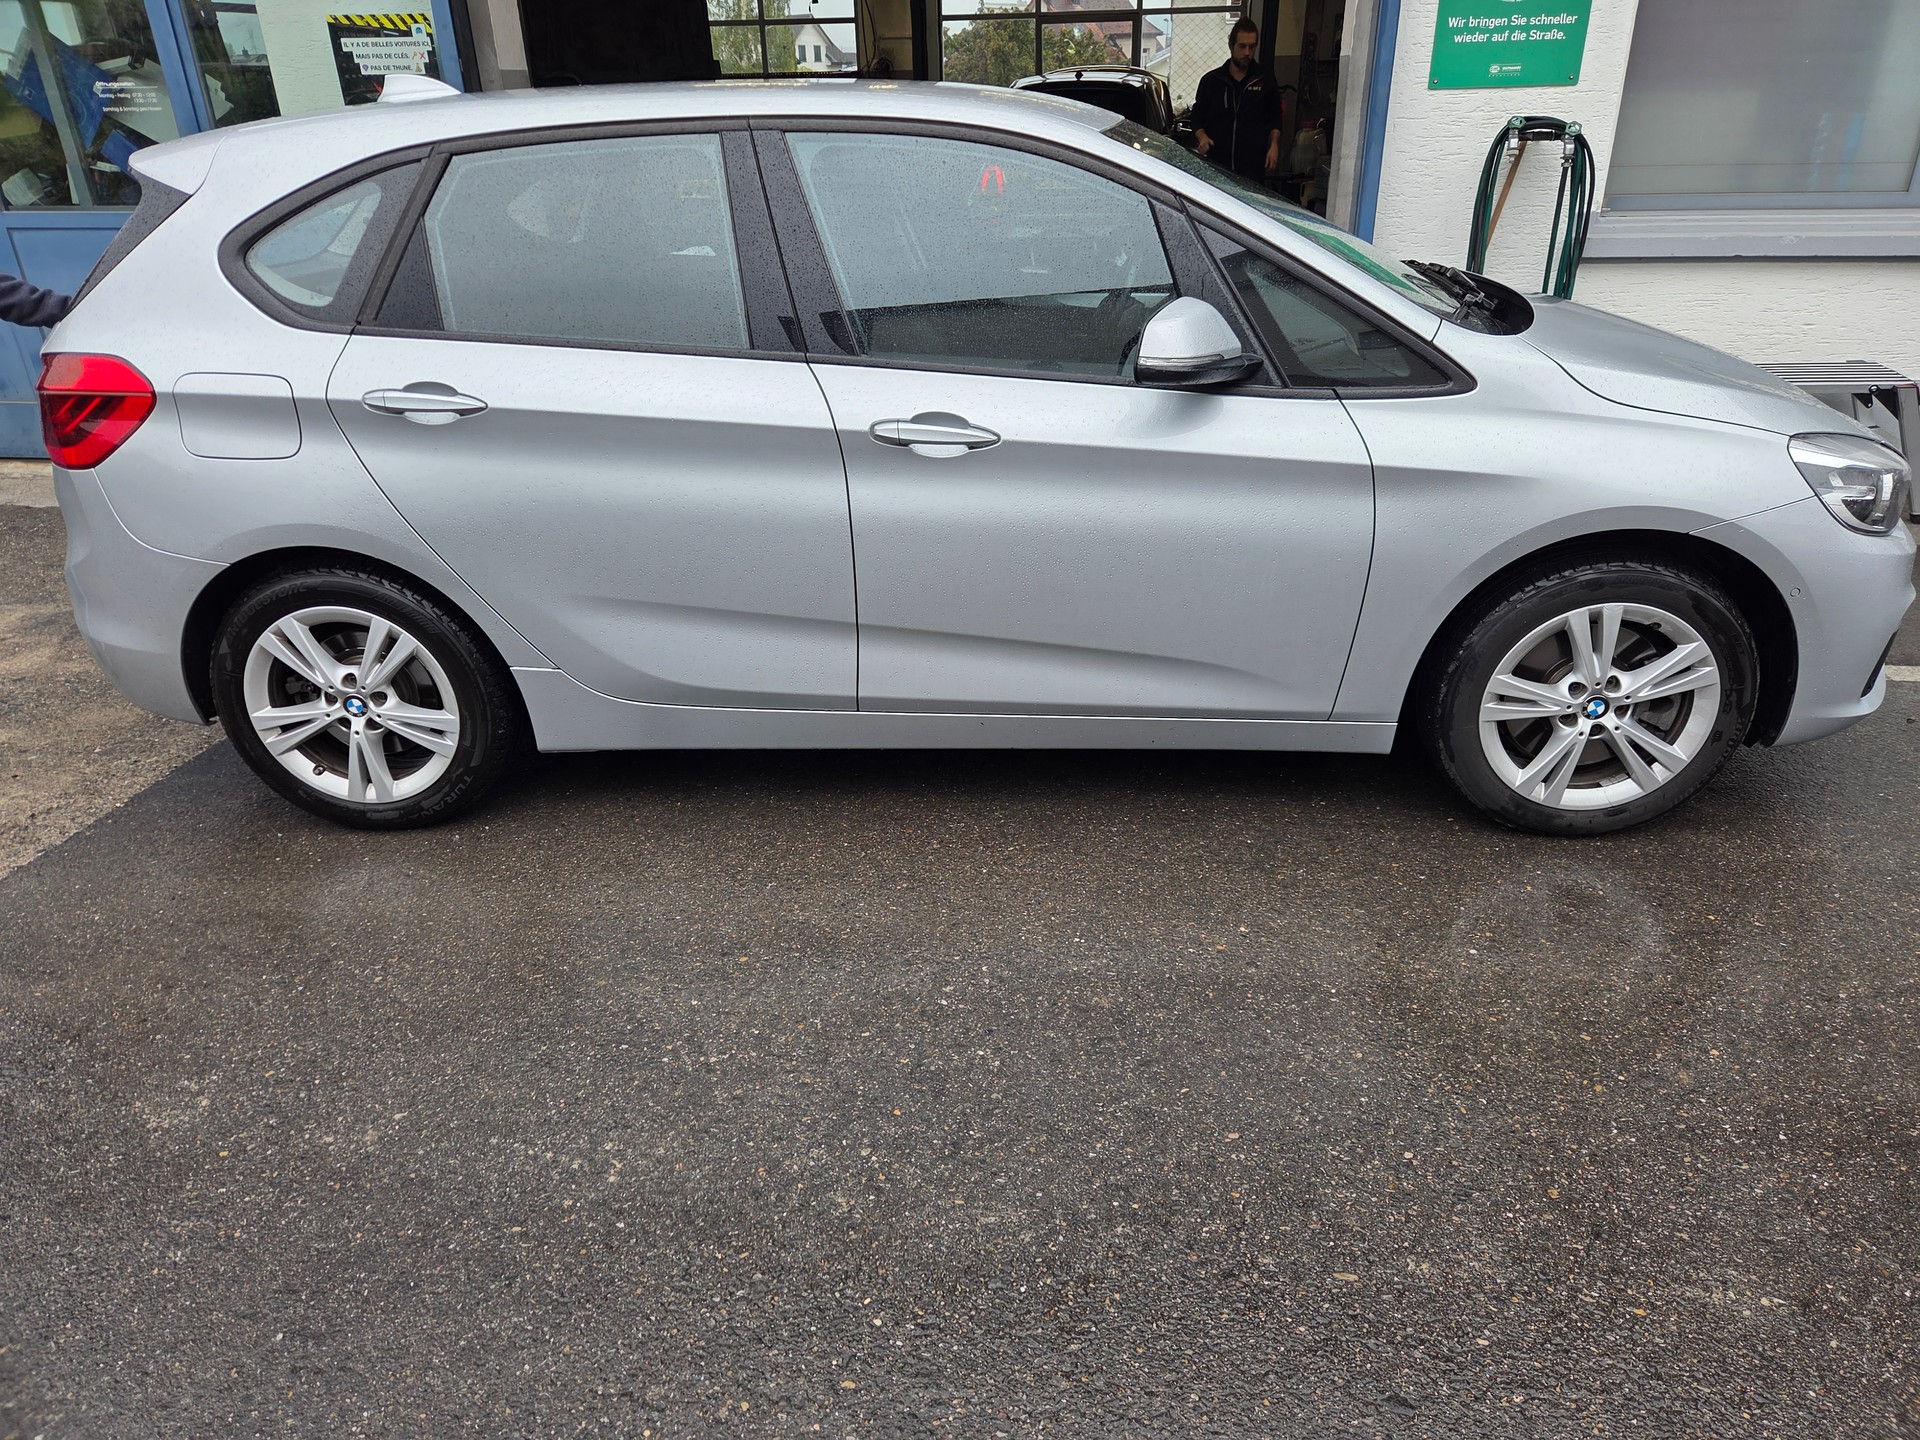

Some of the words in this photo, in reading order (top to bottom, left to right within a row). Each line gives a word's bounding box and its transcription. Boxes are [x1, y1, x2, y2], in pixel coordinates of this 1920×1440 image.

[1448, 16, 1466, 28] Wir
[1468, 16, 1508, 29] bringen
[1510, 14, 1527, 26] Sie
[1529, 13, 1578, 25] schneller
[1454, 32, 1489, 43] wieder
[1491, 30, 1509, 42] auf
[1511, 30, 1527, 41] die
[1529, 29, 1566, 40] Straße.
[393, 51, 410, 59] CLÉS.
